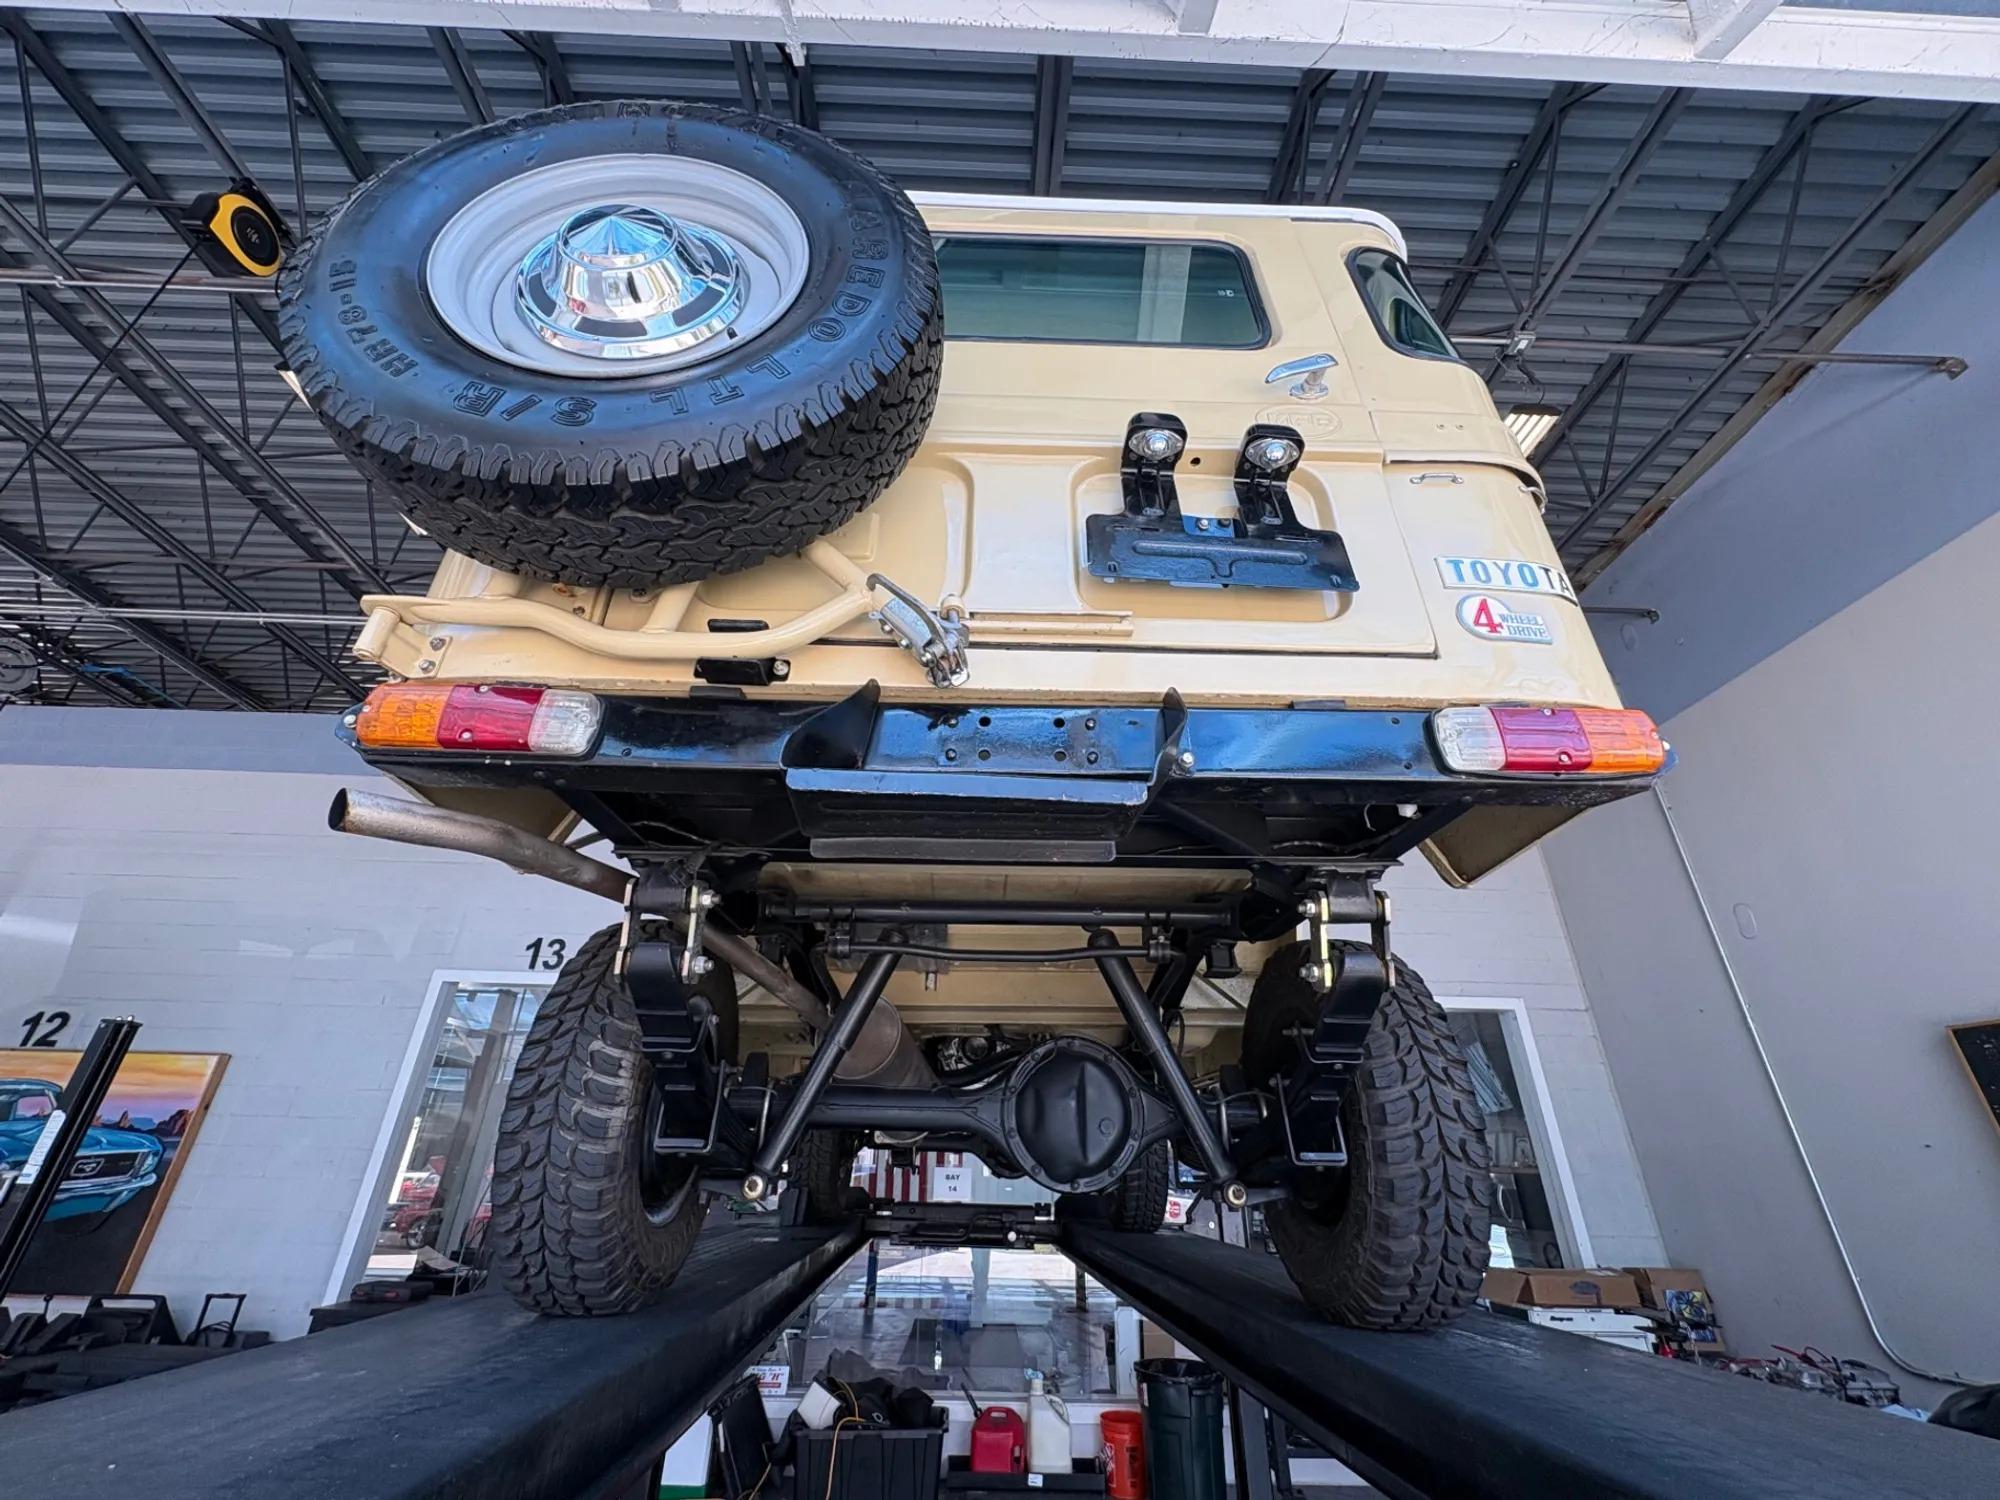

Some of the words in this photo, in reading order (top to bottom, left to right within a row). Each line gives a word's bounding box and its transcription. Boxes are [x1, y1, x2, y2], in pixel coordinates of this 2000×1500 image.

[1445, 559, 1576, 599] TOYOTA
[1473, 598, 1504, 634] 4
[1499, 613, 1545, 627] WHEEL
[1507, 625, 1549, 638] DRIVE
[525, 937, 566, 970] 13
[19, 1011, 71, 1047] 12
